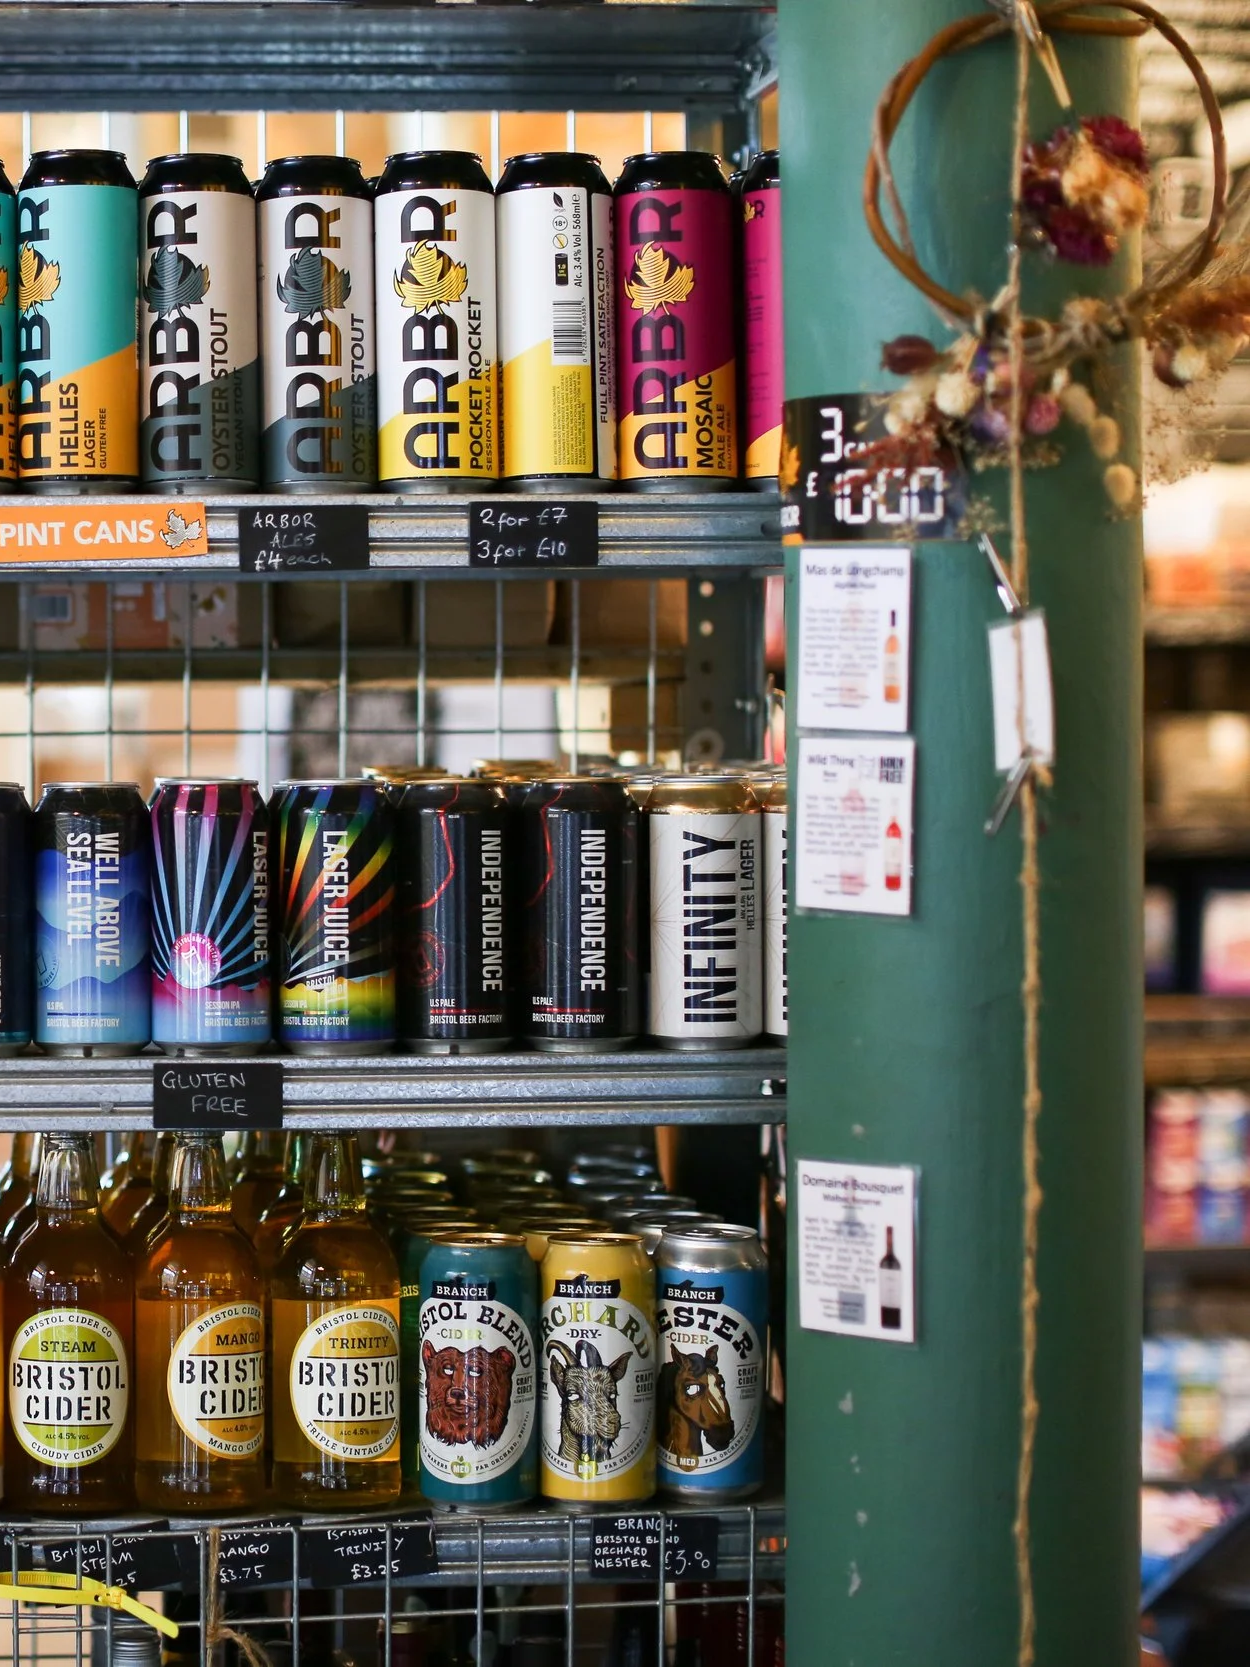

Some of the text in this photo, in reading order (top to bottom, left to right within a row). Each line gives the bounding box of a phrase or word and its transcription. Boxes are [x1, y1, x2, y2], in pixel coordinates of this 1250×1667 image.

[597, 248, 608, 423] FULL PINT SATISFACTION
[468, 296, 483, 470] POCKET ROCKET
[59, 382, 78, 469] HELLES
[696, 375, 714, 469] MOSAIC
[820, 407, 843, 463] 3
[85, 420, 95, 468] LAGER
[0, 522, 65, 547] PINT
[74, 519, 155, 545] CANS
[253, 512, 316, 529] ARBOR
[270, 533, 316, 549] ALES
[254, 550, 331, 572] £4 each
[322, 831, 349, 898] LASER
[253, 831, 268, 962] LASER JUICE
[740, 839, 755, 930] HELLES LAGER
[95, 832, 120, 968] WELL ABOVE
[481, 830, 503, 991] INDEPENDENCE
[580, 829, 606, 991] INDEPENDENCE
[323, 903, 349, 963] JUICE
[683, 830, 737, 1023] INFINITY
[429, 1014, 503, 1024] BRISTOL BEER FACTORY
[532, 1013, 605, 1023] BRISTOL BEER FACTORY
[162, 1070, 246, 1090] GLUTEN
[191, 1095, 249, 1117] FREE
[436, 1285, 488, 1297] BRANCH
[559, 1284, 612, 1294] BRANCH
[667, 1287, 716, 1300] BRANCH
[41, 1340, 96, 1353] STEAM
[216, 1334, 260, 1346] MANGO
[329, 1335, 389, 1349] TRINITY
[12, 1362, 126, 1391] BRISTOL
[299, 1360, 400, 1387] BRISTOL
[26, 1394, 111, 1421] CIDER
[317, 1390, 395, 1417] CIDER
[594, 1546, 648, 1556] ORCHARD
[595, 1535, 680, 1544] BRISTOL BLND
[219, 1564, 266, 1584] £3.75
[351, 1560, 400, 1580] £3.25
[594, 1558, 651, 1568] WESTER
